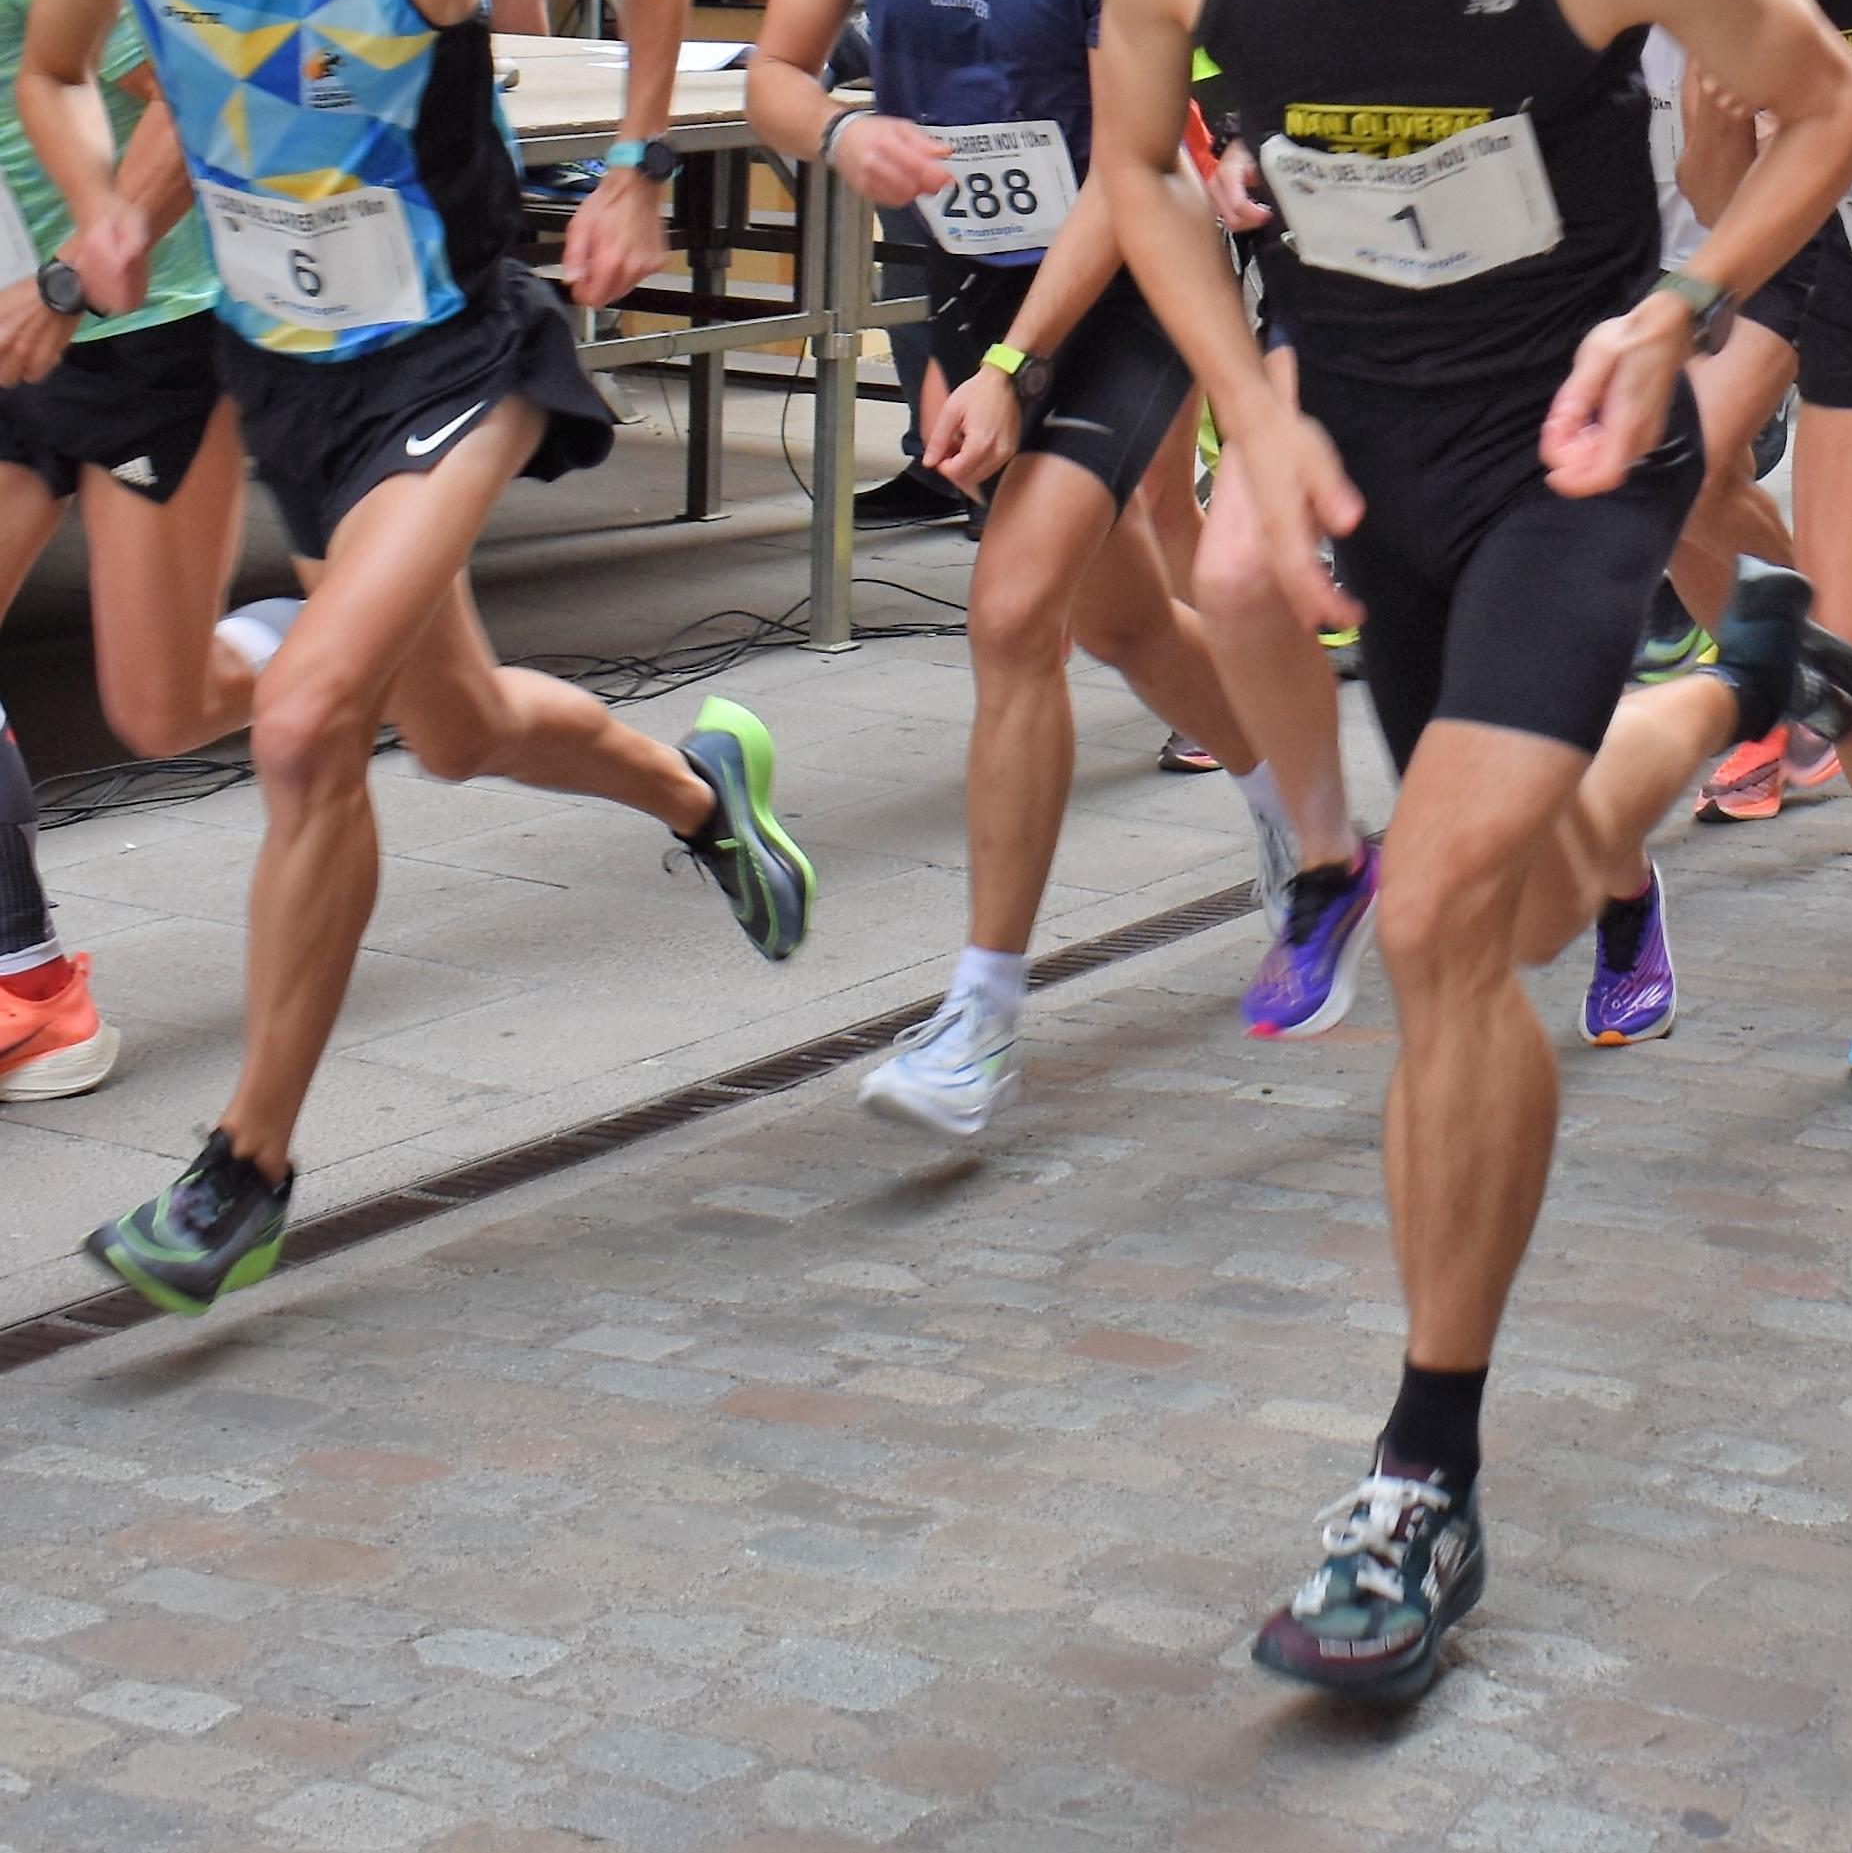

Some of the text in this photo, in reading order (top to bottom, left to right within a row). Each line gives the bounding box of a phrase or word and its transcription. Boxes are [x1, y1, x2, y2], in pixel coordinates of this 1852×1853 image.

[943, 168, 1038, 219] 288
[1389, 204, 1429, 249] 1
[289, 248, 321, 297] 6
